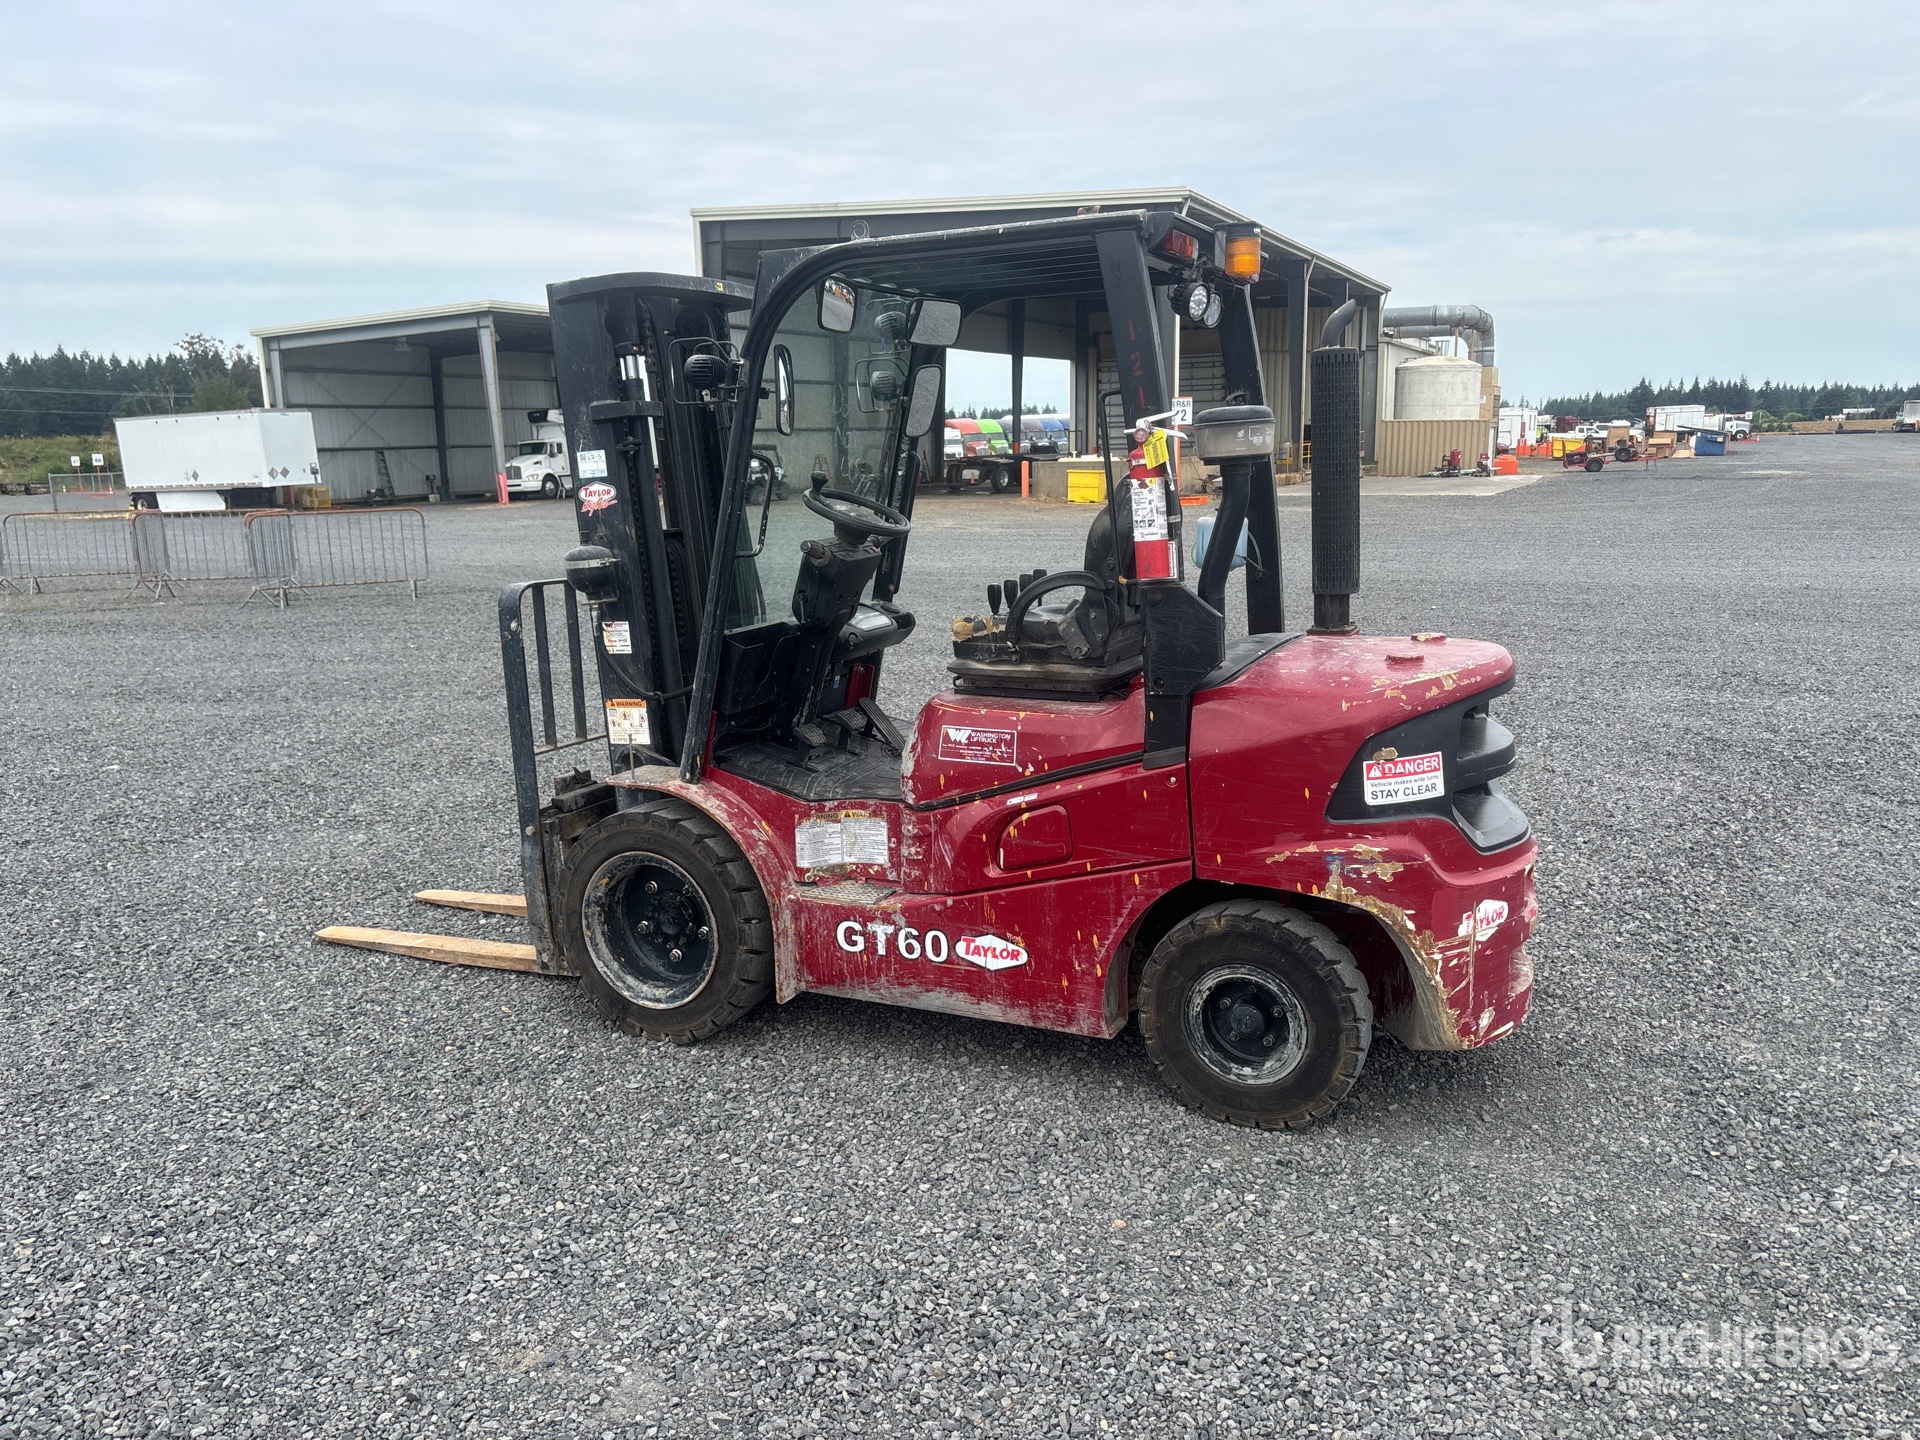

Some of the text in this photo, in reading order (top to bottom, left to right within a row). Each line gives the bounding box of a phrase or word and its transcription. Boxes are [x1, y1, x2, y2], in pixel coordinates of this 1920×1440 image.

[1176, 400, 1191, 408] R&R
[1180, 409, 1187, 421] 2
[583, 487, 612, 498] TAYLOR
[971, 731, 1011, 740] WASHINGTON
[1385, 756, 1440, 776] DANGER
[1370, 780, 1393, 788] Vehicle
[1370, 782, 1438, 801] STAY CLEAR
[836, 920, 950, 963] GT60
[960, 935, 1022, 961] TAYLOR
